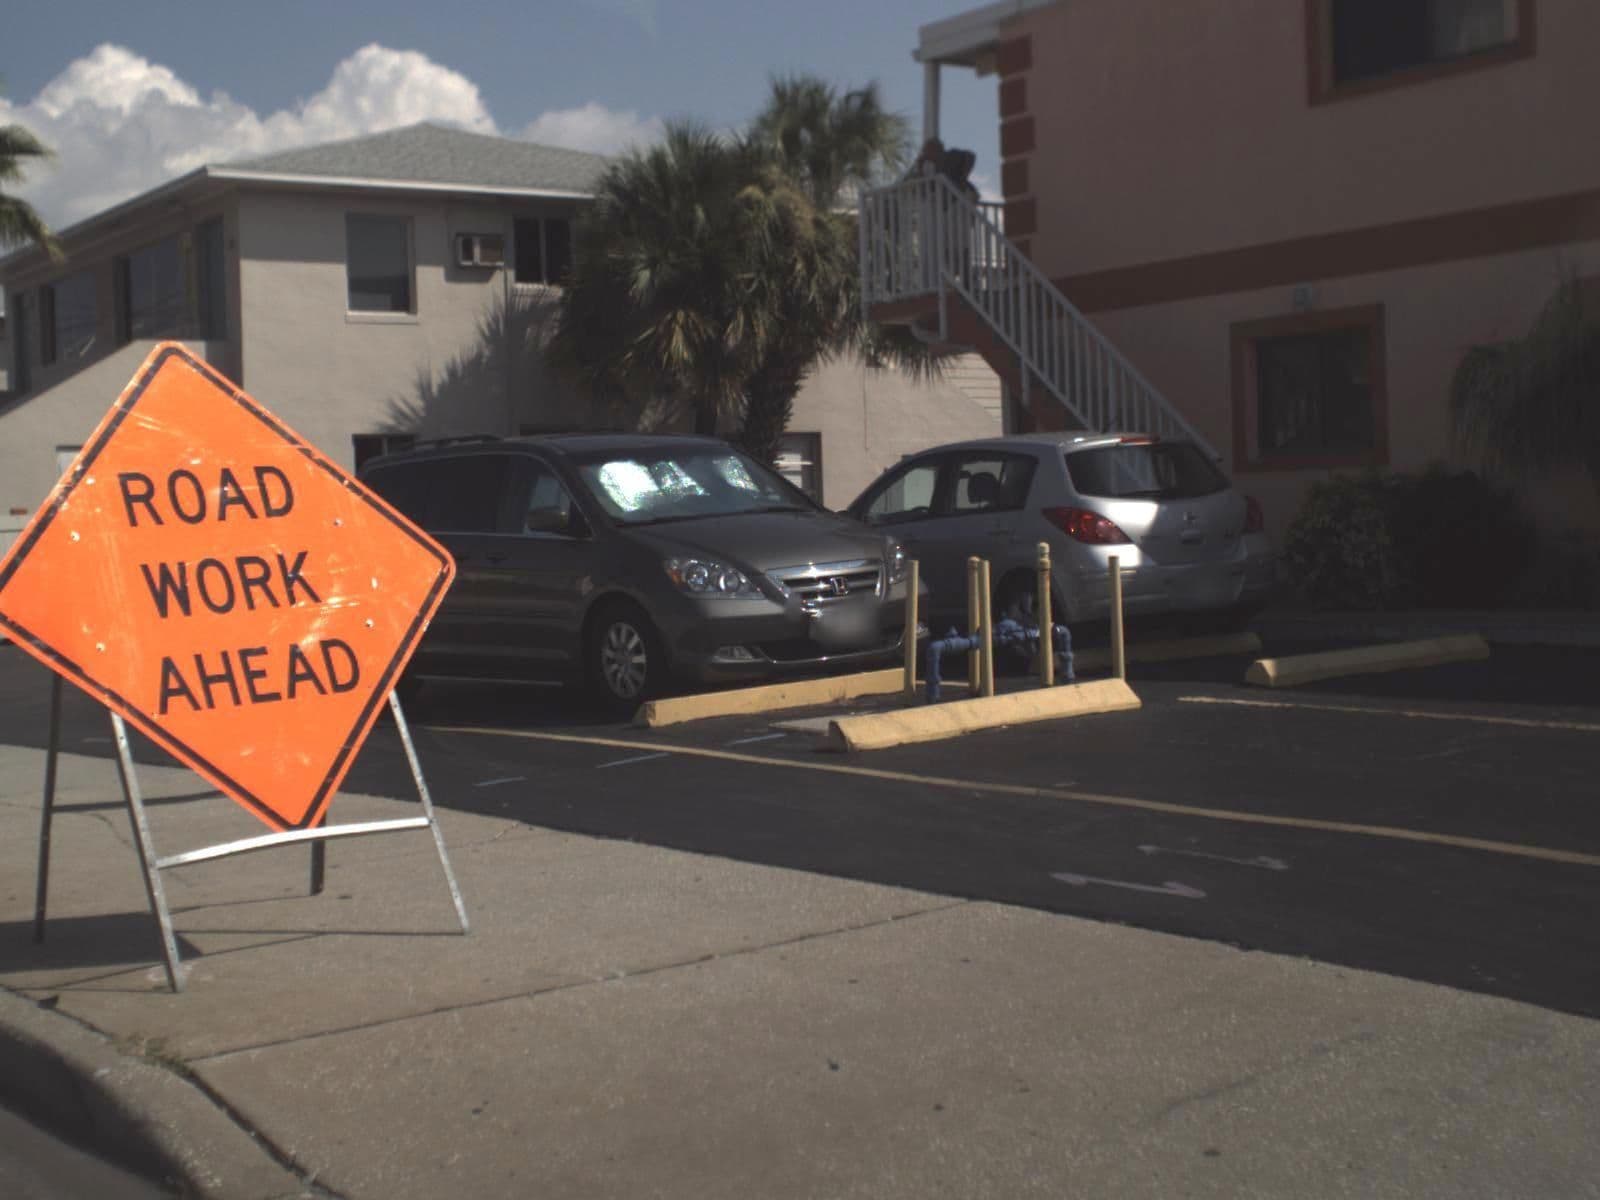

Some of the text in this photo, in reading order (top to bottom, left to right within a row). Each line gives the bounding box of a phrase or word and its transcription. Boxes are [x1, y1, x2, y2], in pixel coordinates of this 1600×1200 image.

[118, 466, 294, 527] ROAD
[141, 551, 322, 618] WORK
[159, 638, 361, 715] AHEAD
